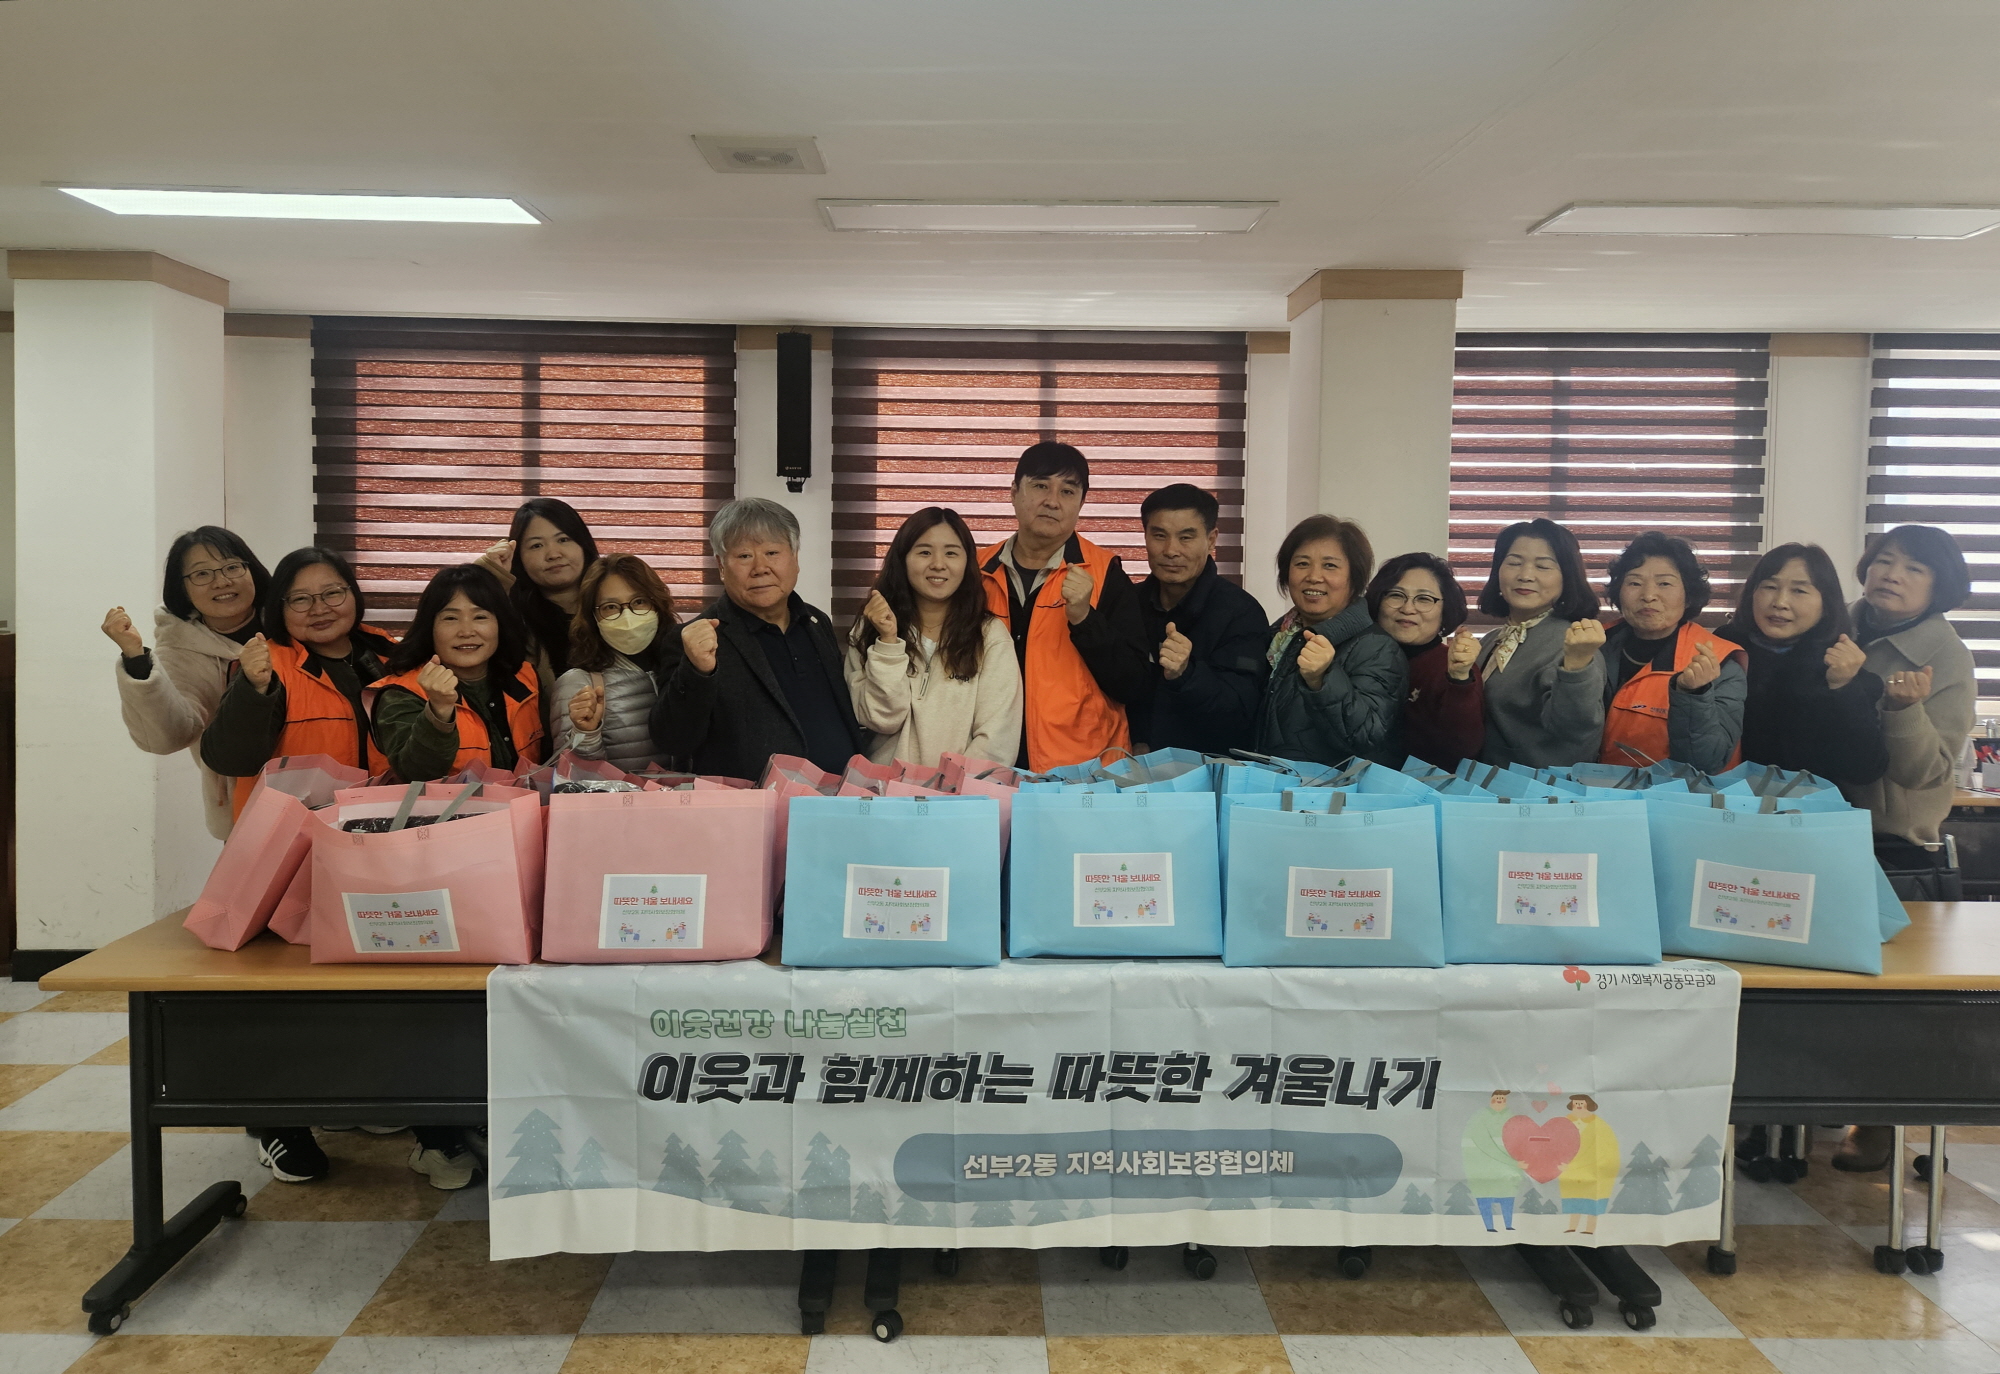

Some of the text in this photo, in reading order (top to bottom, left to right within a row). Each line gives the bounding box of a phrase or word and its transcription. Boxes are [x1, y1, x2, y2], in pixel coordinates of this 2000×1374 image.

[949, 672, 969, 682] Jeep
[1085, 873, 1161, 883] 따뜻한 겨울 보내세요
[1508, 871, 1583, 881] 따뜻한 겨울 보내세요
[858, 887, 937, 898] 따뜻한 겨울 보내세요
[1300, 888, 1381, 898] 따뜻한 겨울 보내세요
[1708, 880, 1801, 900] 따뜻한 겨울 보내세요
[613, 896, 693, 906] 따뜻한 겨울 보내세요
[357, 908, 439, 919] 따뜻한 겨울 보내세요
[1595, 973, 1716, 990] 경기 사회복지공동모금회
[650, 1007, 907, 1039] 이웃건강 나눔실천
[637, 1050, 1442, 1111] 이웃과 함께하는 따뜻한 겨울나기
[963, 1149, 1294, 1180] 선부2동 지역사회보장협의체
